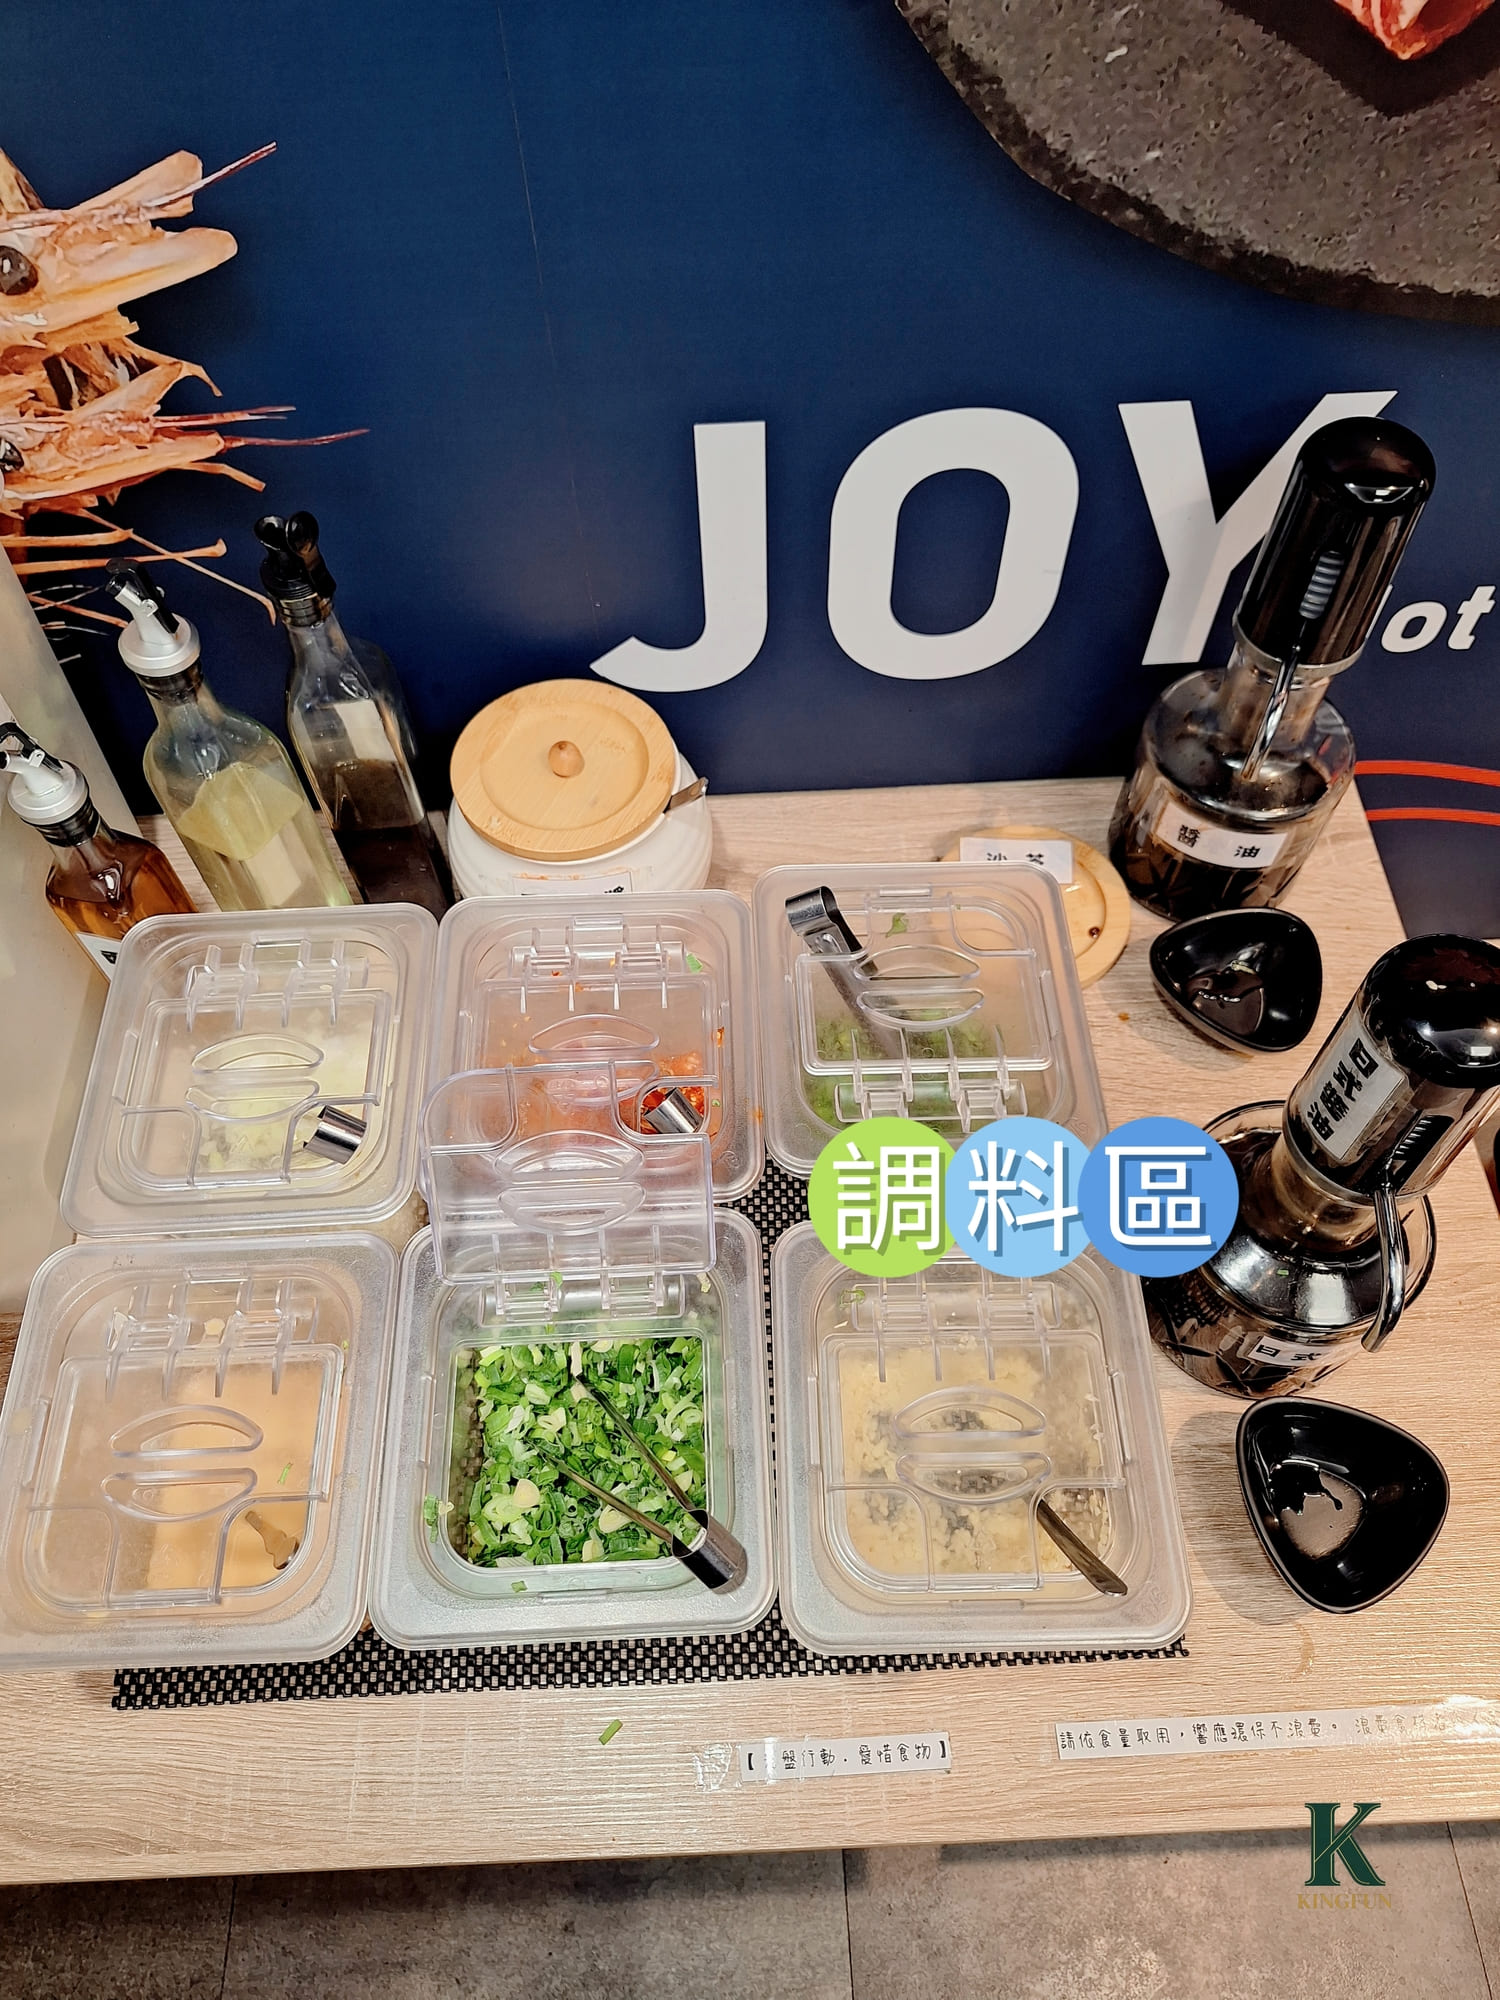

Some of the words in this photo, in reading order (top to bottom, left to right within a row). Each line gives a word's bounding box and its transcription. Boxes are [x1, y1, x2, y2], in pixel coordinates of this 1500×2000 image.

[590, 390, 1399, 693] JOY
[1365, 584, 1496, 654] ot
[1177, 824, 1261, 859] 醬油
[1307, 1037, 1379, 1142] 日式醬油
